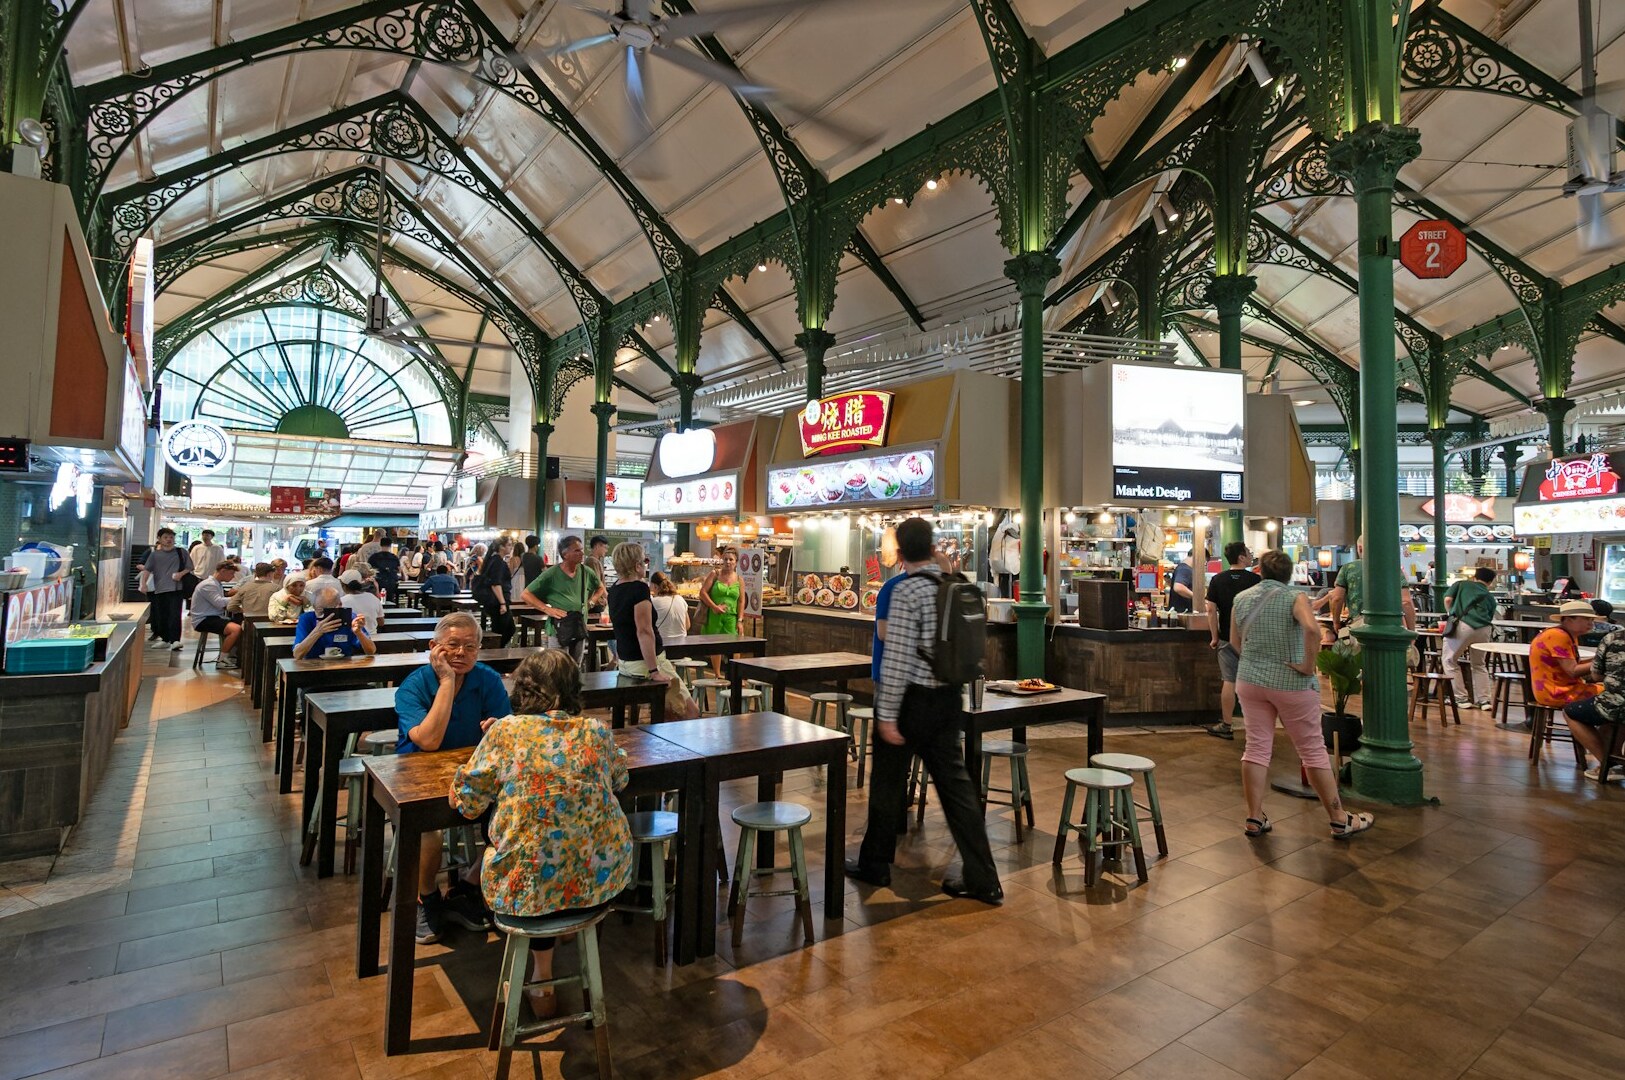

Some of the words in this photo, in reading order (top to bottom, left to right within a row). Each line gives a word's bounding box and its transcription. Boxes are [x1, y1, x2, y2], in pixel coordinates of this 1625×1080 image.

[1418, 230, 1447, 240] STREET
[1425, 242, 1440, 268] 2
[820, 394, 866, 432] 烧腊
[811, 433, 827, 443] MING
[827, 430, 841, 441] KEE
[841, 424, 873, 438] ROASTED
[1115, 484, 1155, 497] Market
[1155, 486, 1191, 501] Design
[1552, 489, 1577, 498] CHINESE
[1577, 486, 1602, 496] CUISINE
